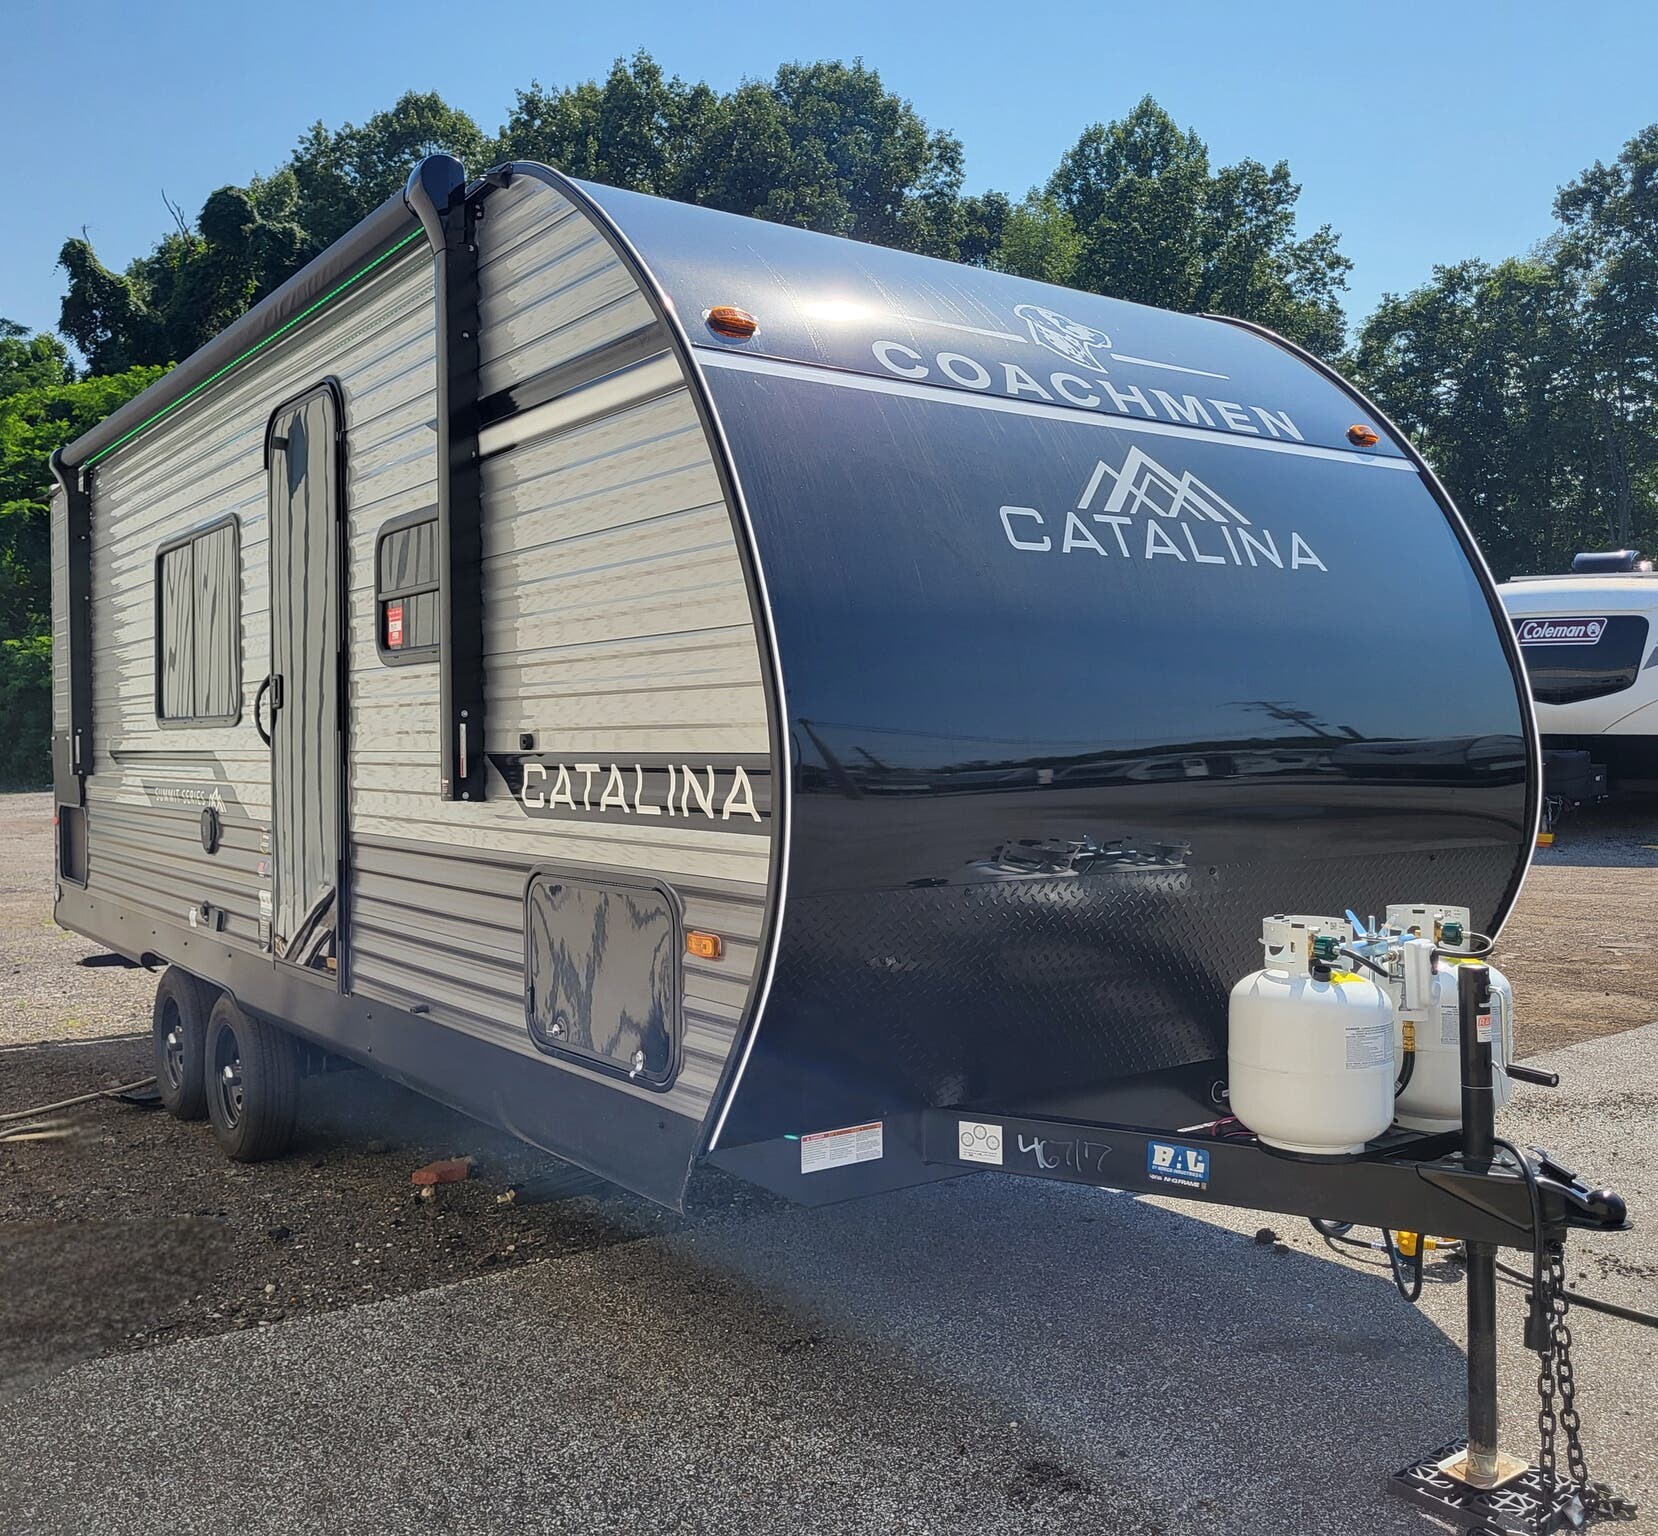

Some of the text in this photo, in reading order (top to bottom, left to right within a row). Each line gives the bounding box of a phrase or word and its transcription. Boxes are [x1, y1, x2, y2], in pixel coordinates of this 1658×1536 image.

[870, 339, 1305, 442] COACHMEN
[999, 505, 1329, 573] CATALINA
[1523, 622, 1586, 639] Coleman
[154, 787, 206, 806] SUMMIT SERIES
[521, 763, 763, 823] CATALINA
[1152, 1144, 1205, 1174] BAL
